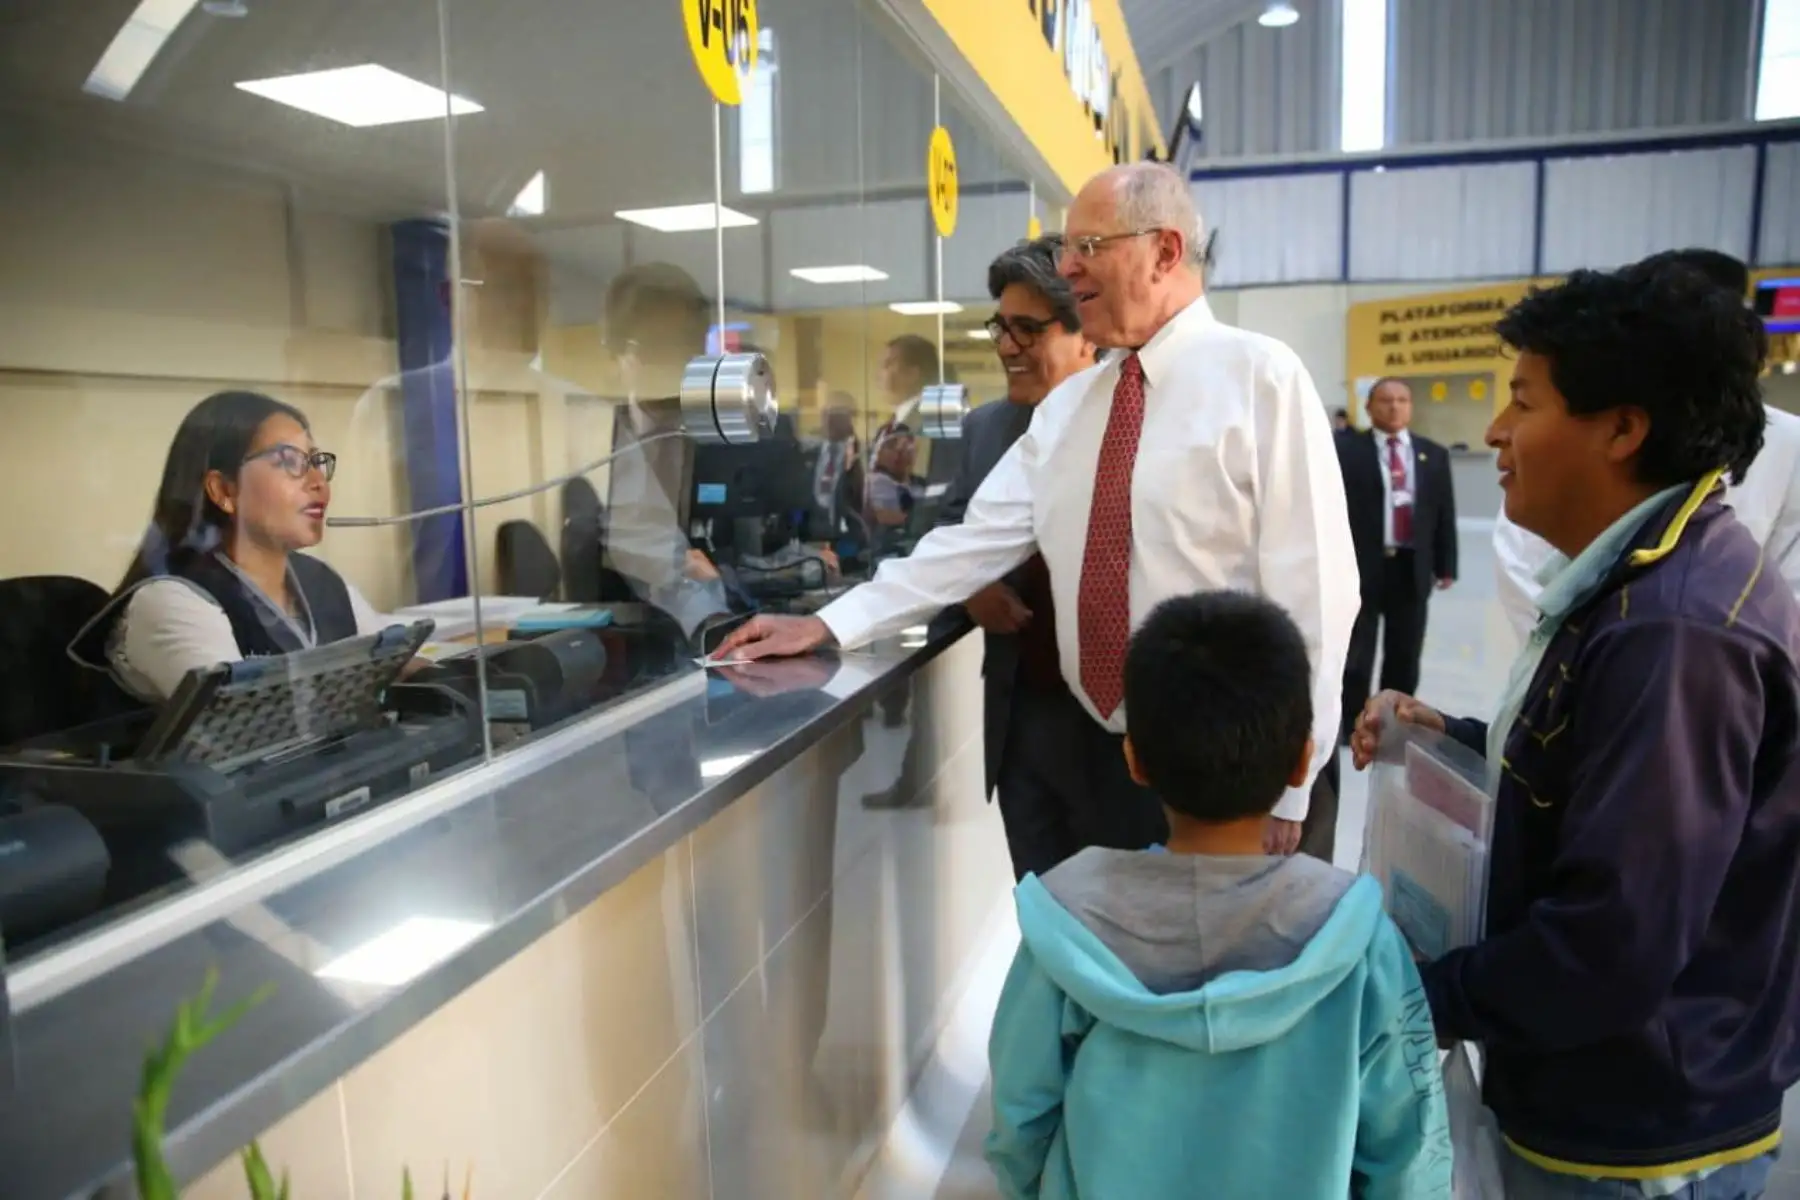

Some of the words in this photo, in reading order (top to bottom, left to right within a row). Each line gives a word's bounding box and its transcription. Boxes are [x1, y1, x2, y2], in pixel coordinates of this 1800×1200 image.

[1380, 298, 1504, 324] PLATAFORMA
[1380, 331, 1401, 345] DE
[1408, 321, 1498, 343] ATENCIO
[1385, 352, 1406, 366] AL
